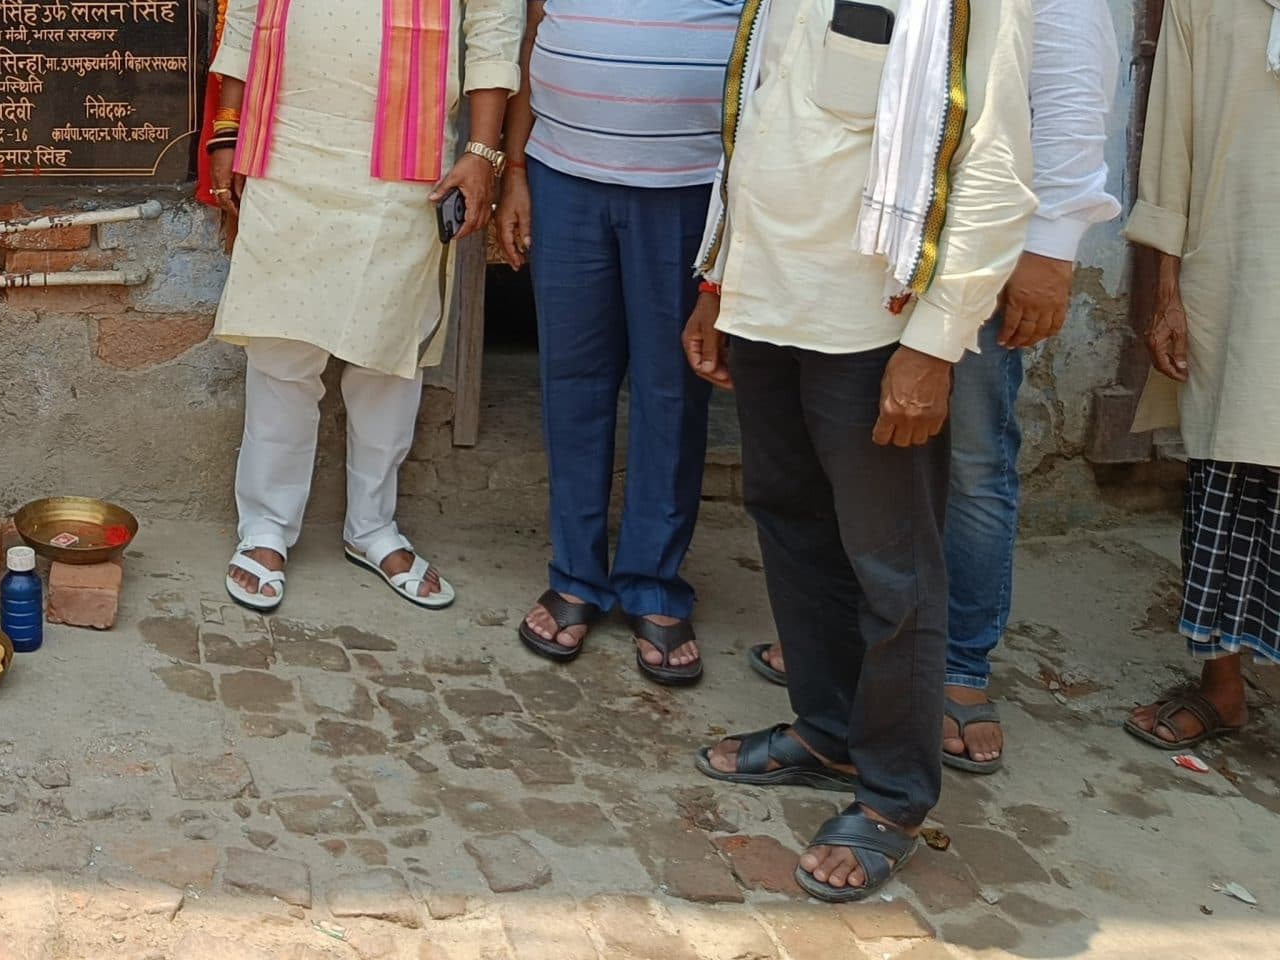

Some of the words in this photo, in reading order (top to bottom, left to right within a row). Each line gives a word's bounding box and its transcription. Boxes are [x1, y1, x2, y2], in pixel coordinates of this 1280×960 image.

[71, 1, 129, 23] ललन
[32, 29, 65, 43] भारत
[68, 29, 118, 43] सरकार
[124, 50, 151, 73] बिहार
[151, 56, 188, 72] सरकार
[33, 145, 72, 166] सिंह
